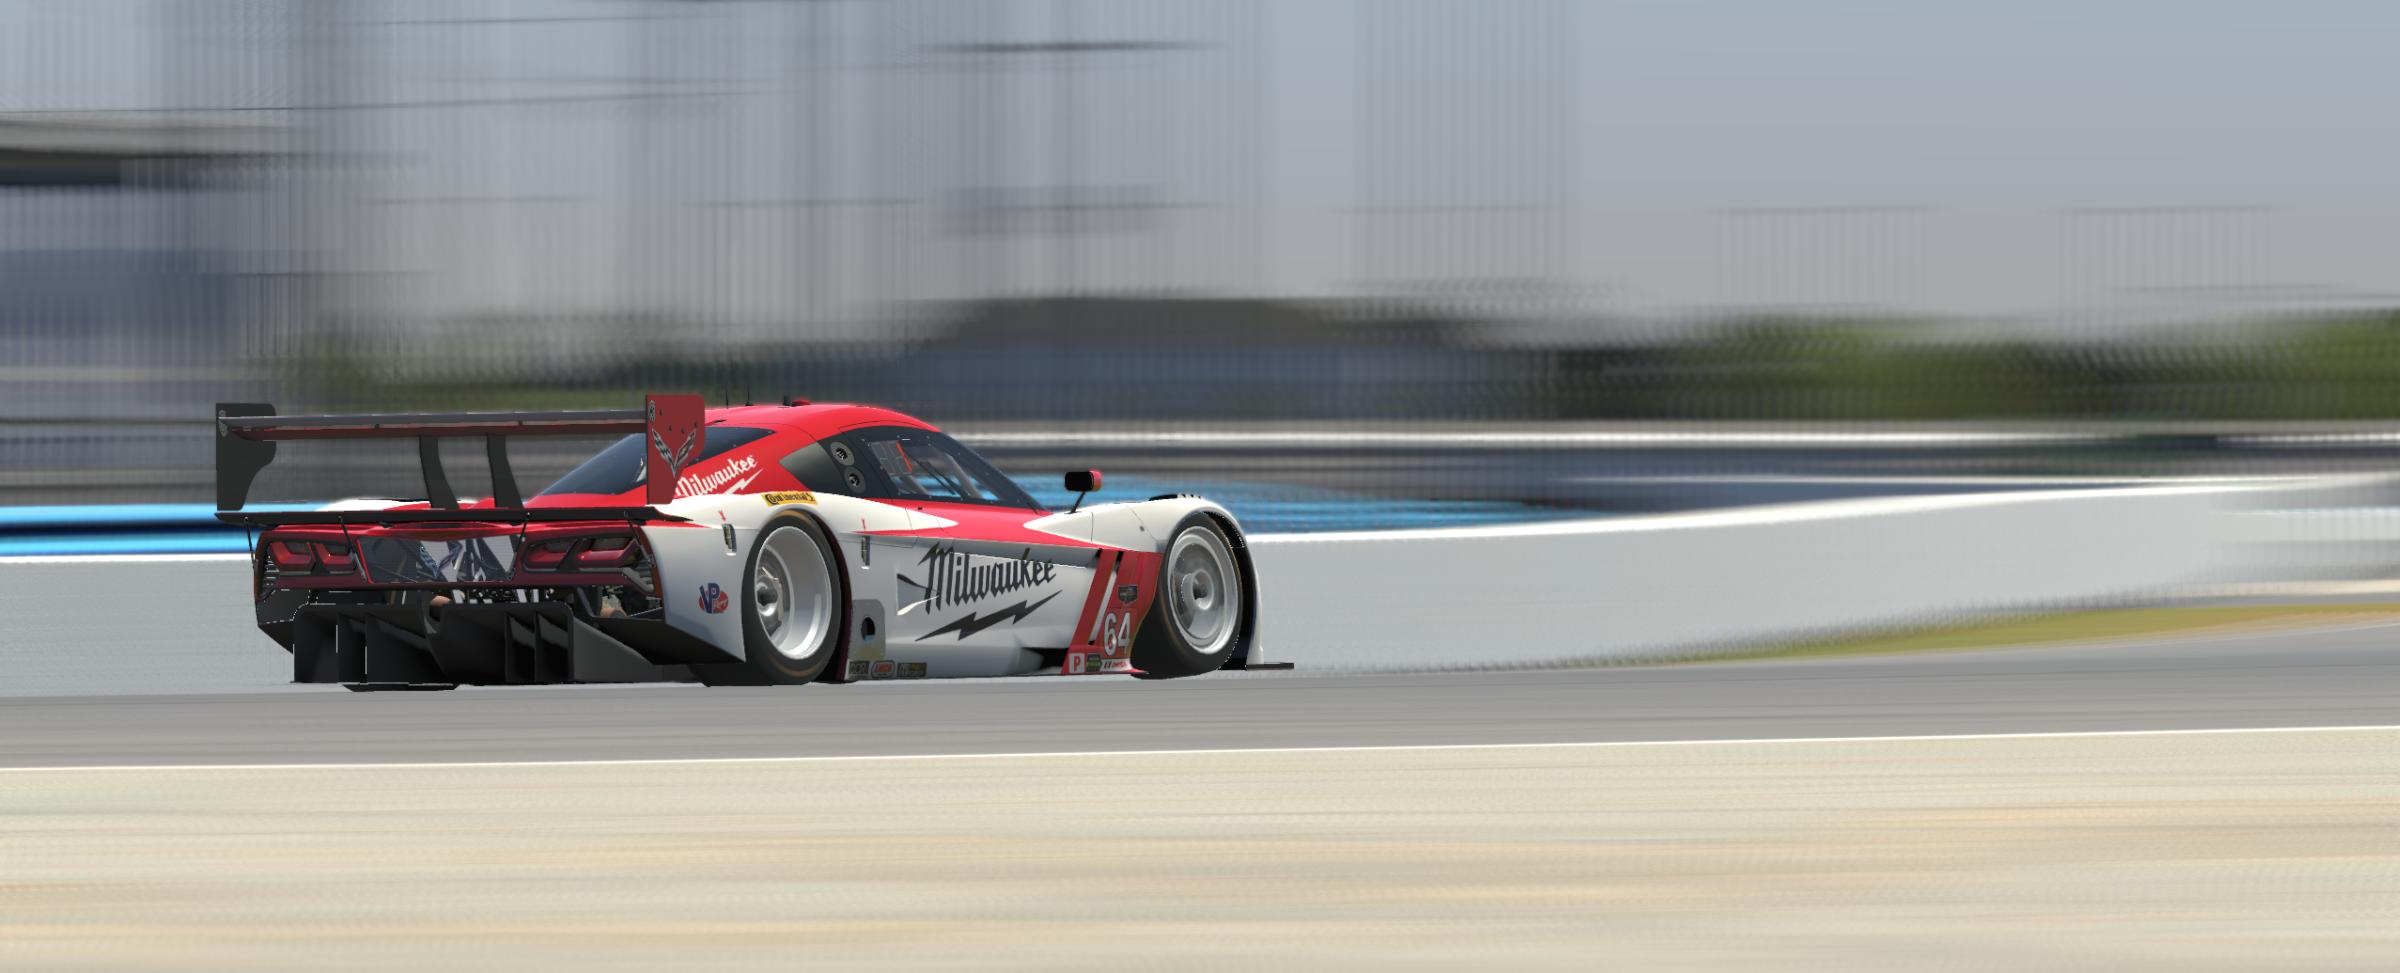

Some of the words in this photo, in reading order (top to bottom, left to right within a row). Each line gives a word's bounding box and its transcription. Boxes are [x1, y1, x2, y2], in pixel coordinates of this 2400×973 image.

[675, 455, 757, 497] Milwaukee
[699, 583, 720, 614] VP
[917, 542, 1056, 614] Milwaukee
[1104, 612, 1131, 656] 64
[1073, 656, 1081, 672] P
